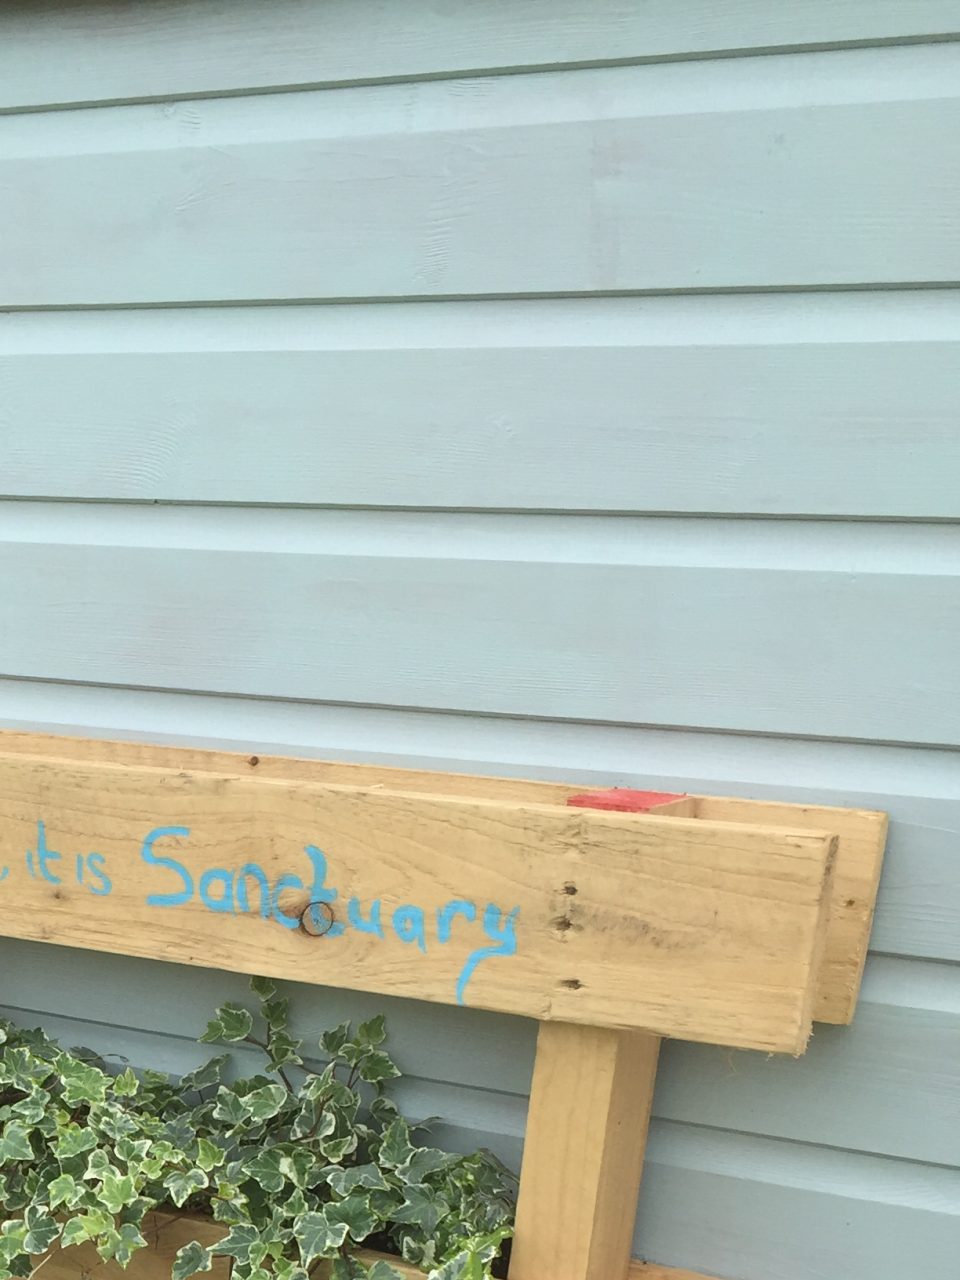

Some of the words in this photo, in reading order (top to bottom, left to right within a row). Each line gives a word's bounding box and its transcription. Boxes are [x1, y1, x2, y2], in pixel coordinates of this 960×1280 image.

[25, 819, 61, 884] it
[76, 853, 112, 896] is
[141, 825, 520, 1007] Sanctuary
